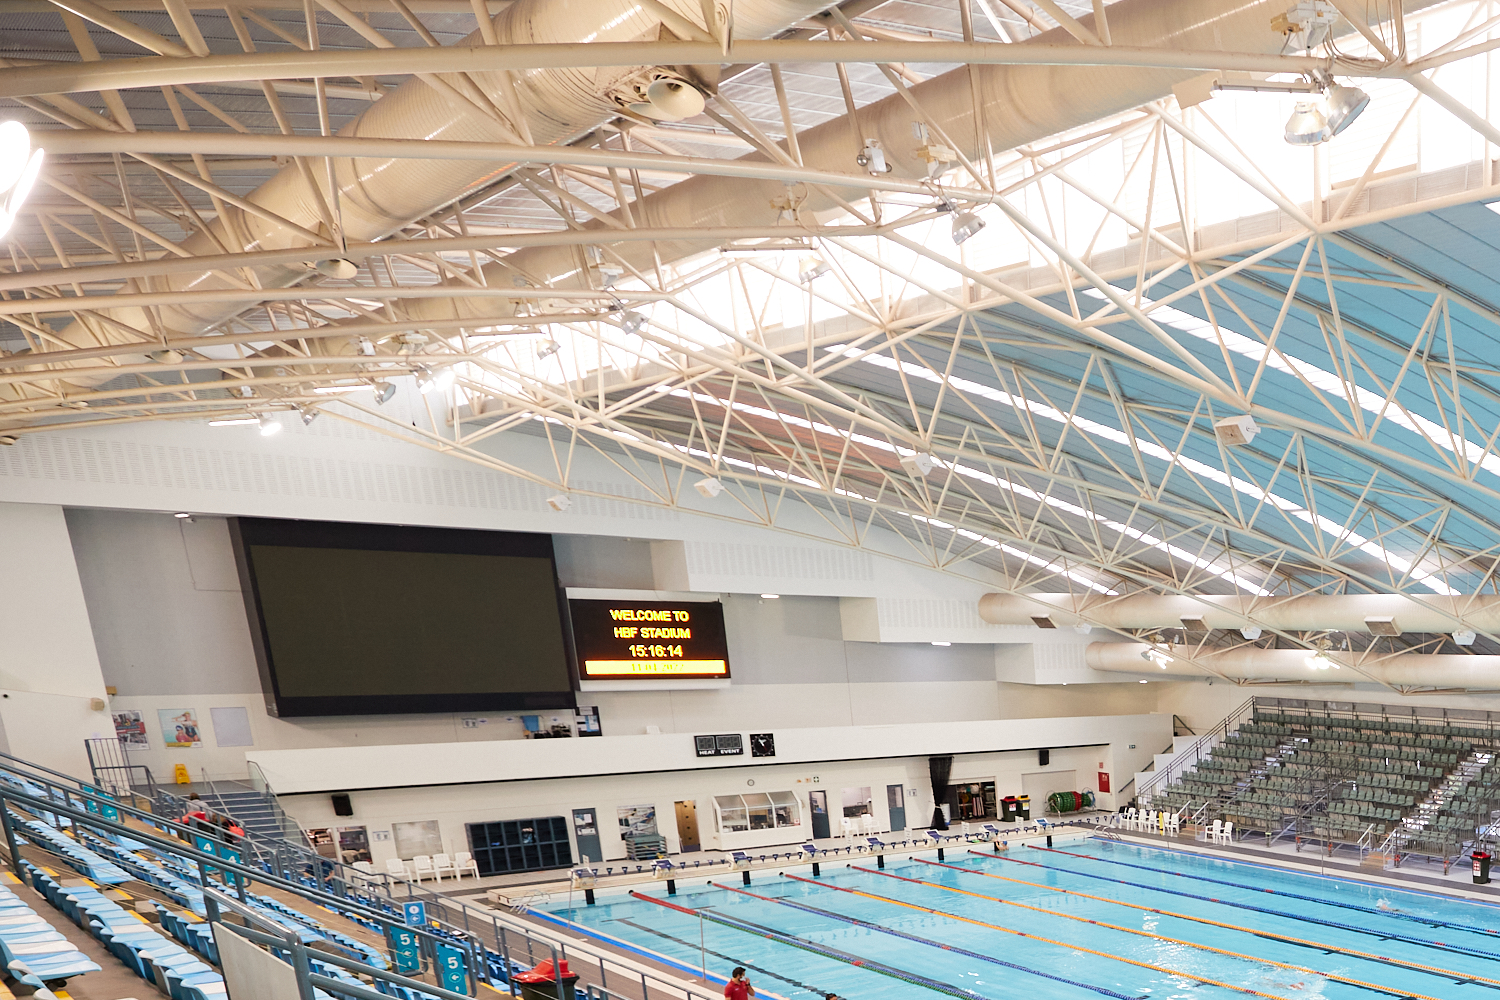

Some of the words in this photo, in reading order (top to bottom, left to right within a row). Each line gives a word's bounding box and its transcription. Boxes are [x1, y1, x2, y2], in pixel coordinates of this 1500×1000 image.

[609, 609, 672, 621] WELCOME
[672, 610, 690, 622] TO
[613, 626, 638, 639] HBF
[640, 627, 691, 639] STADIUM
[628, 644, 683, 657] 15:16:14
[203, 842, 212, 851] 4
[228, 855, 237, 864] 4
[399, 933, 410, 946] 5
[447, 956, 459, 969] 5
